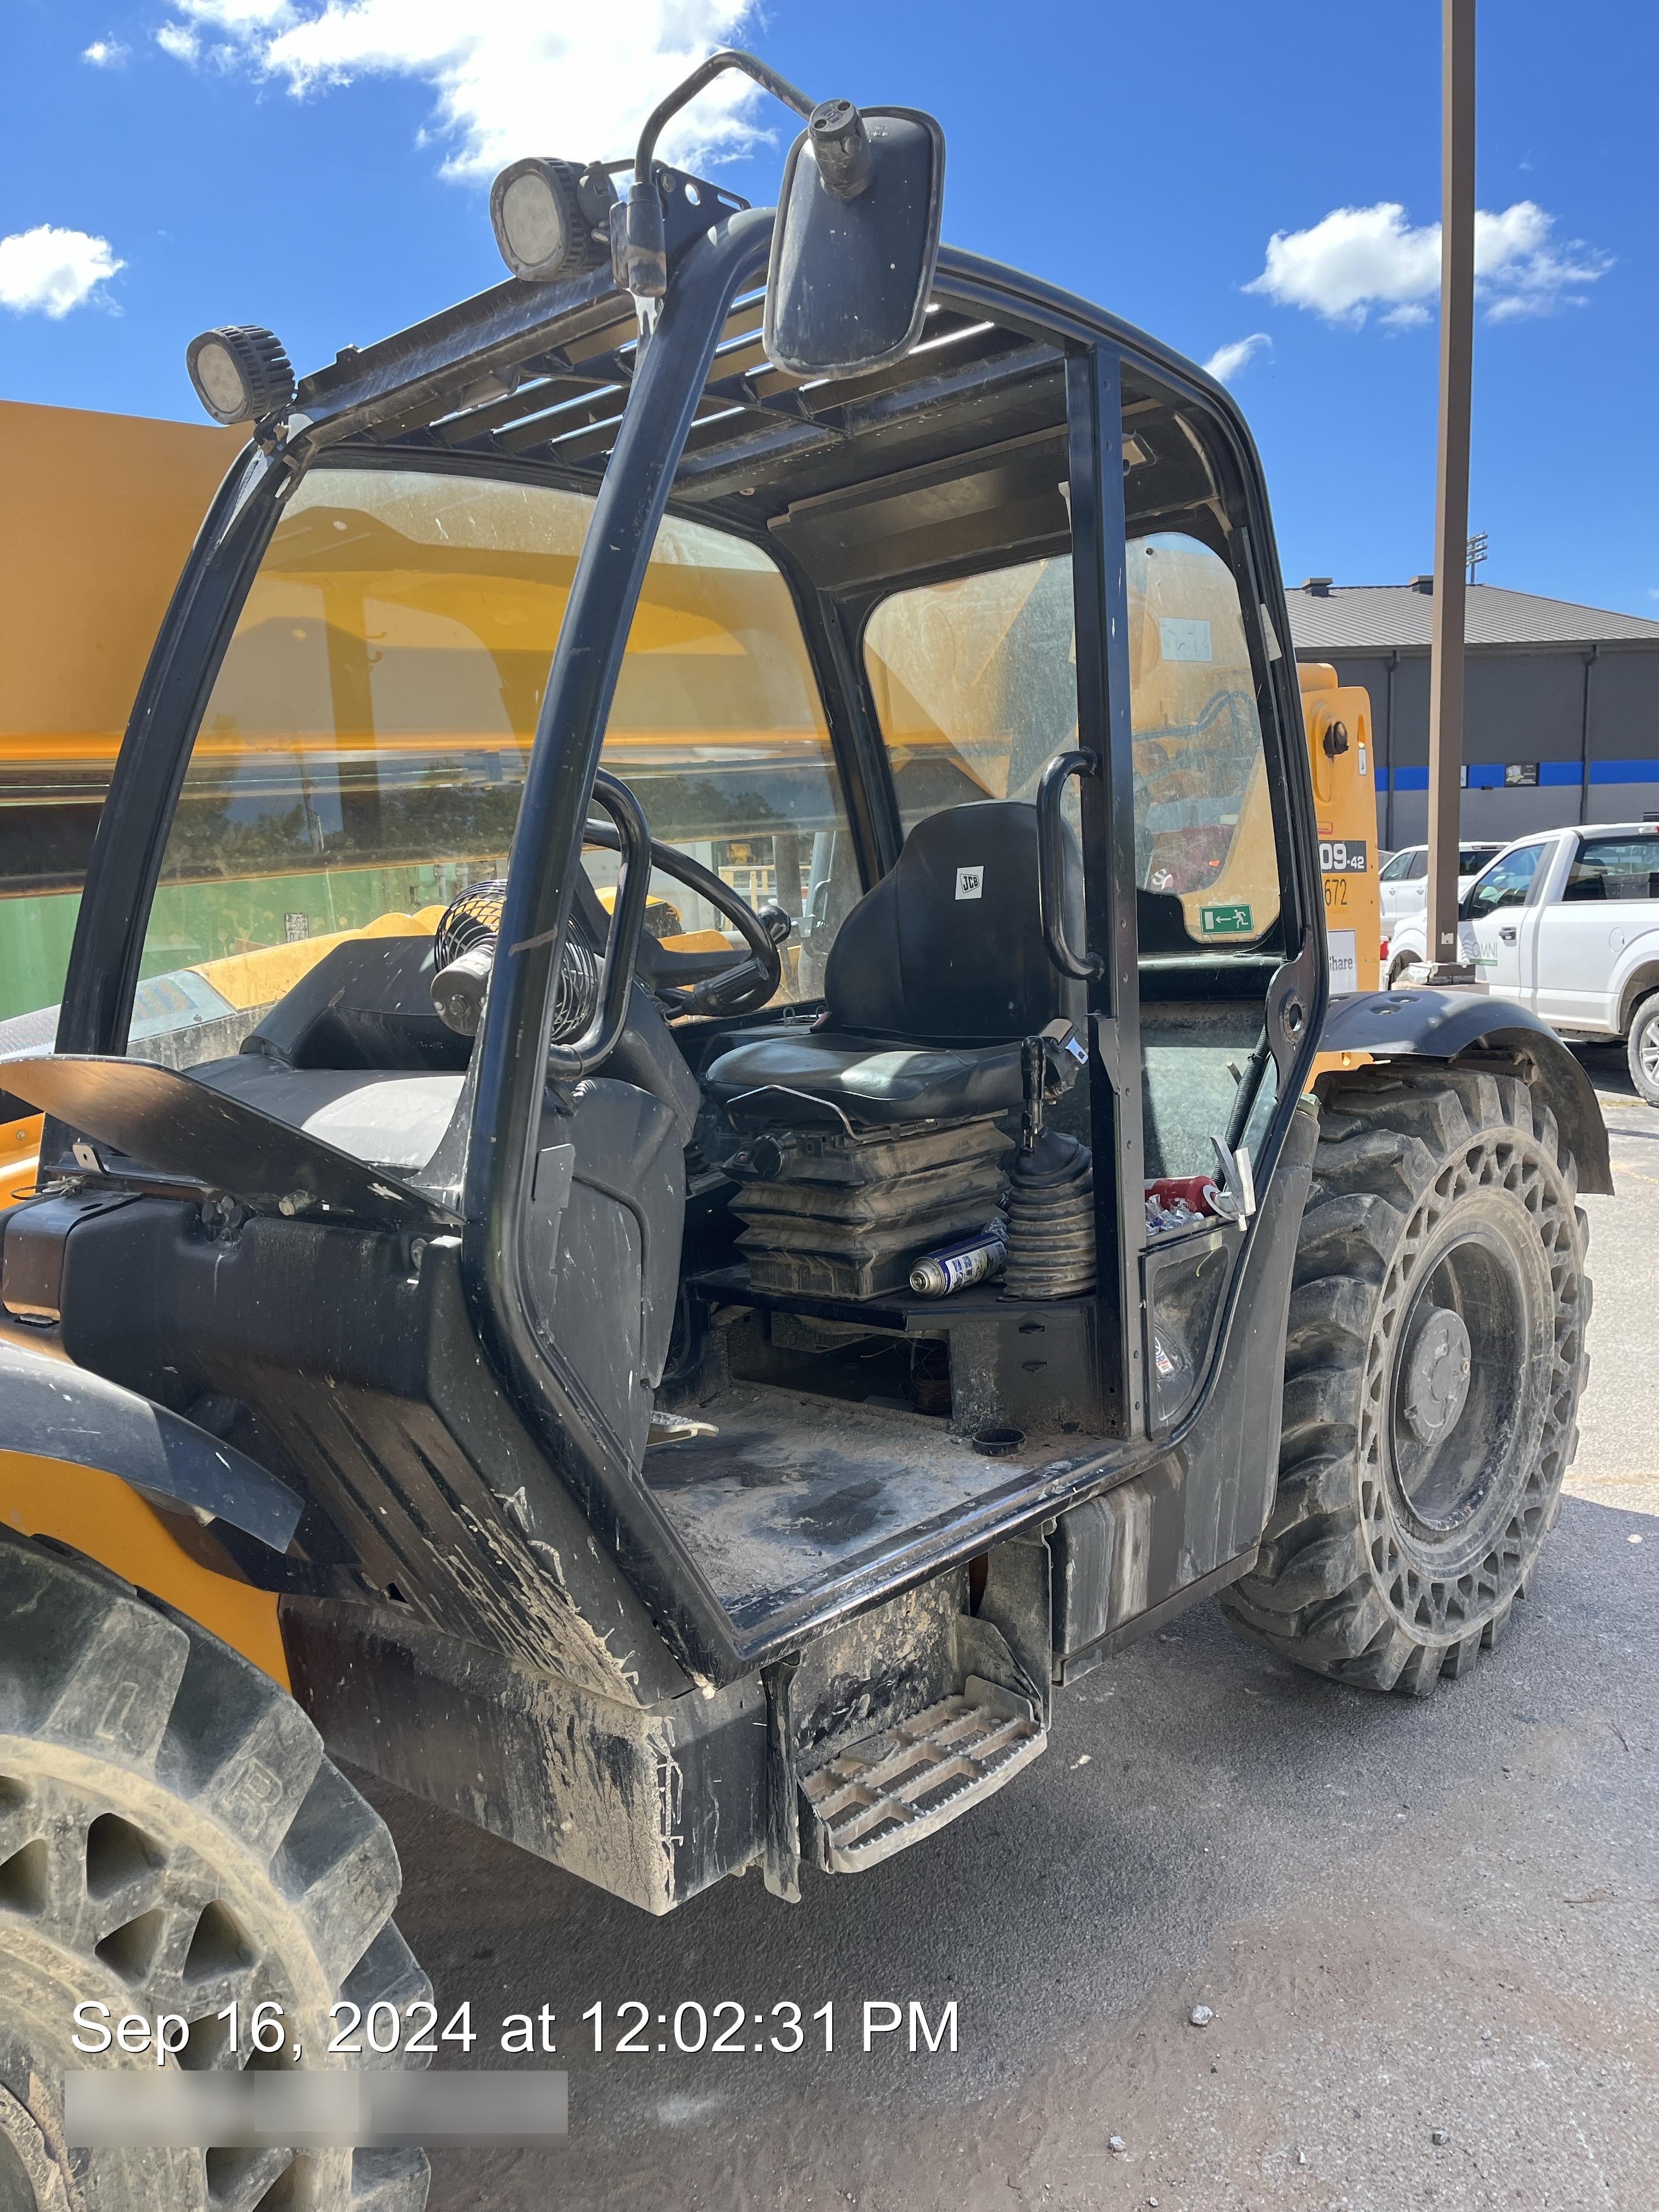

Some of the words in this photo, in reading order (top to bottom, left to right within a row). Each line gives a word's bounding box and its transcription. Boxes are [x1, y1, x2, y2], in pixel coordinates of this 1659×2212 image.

[963, 876, 978, 891] JCB
[1324, 879, 1347, 906] 672
[1472, 941, 1498, 957] OMNI
